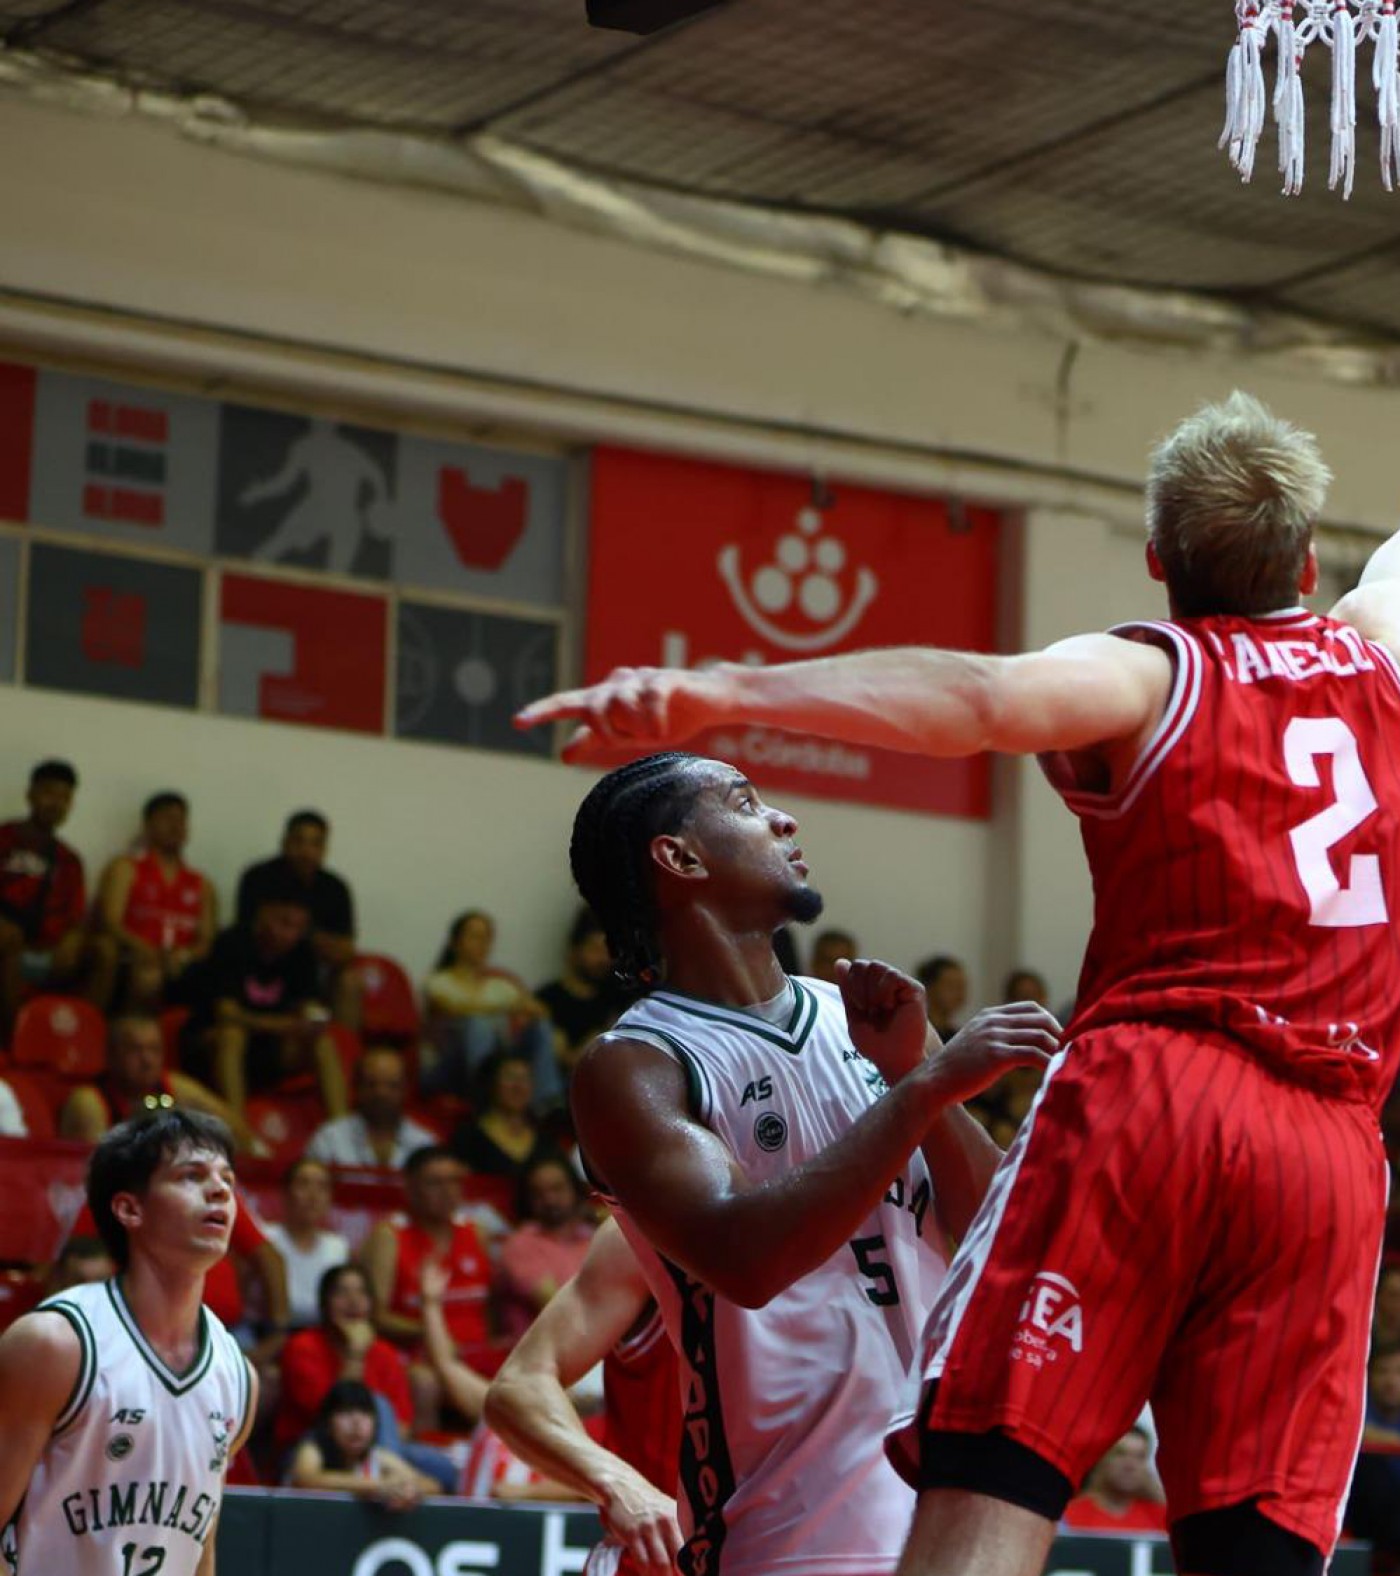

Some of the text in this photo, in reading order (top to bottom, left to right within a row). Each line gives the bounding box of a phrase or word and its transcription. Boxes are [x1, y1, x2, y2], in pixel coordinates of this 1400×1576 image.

[1283, 717, 1389, 926] 2
[739, 1076, 773, 1108] AS
[849, 1234, 899, 1306] 5
[1019, 1285, 1083, 1353] EA
[110, 1408, 147, 1424] AS
